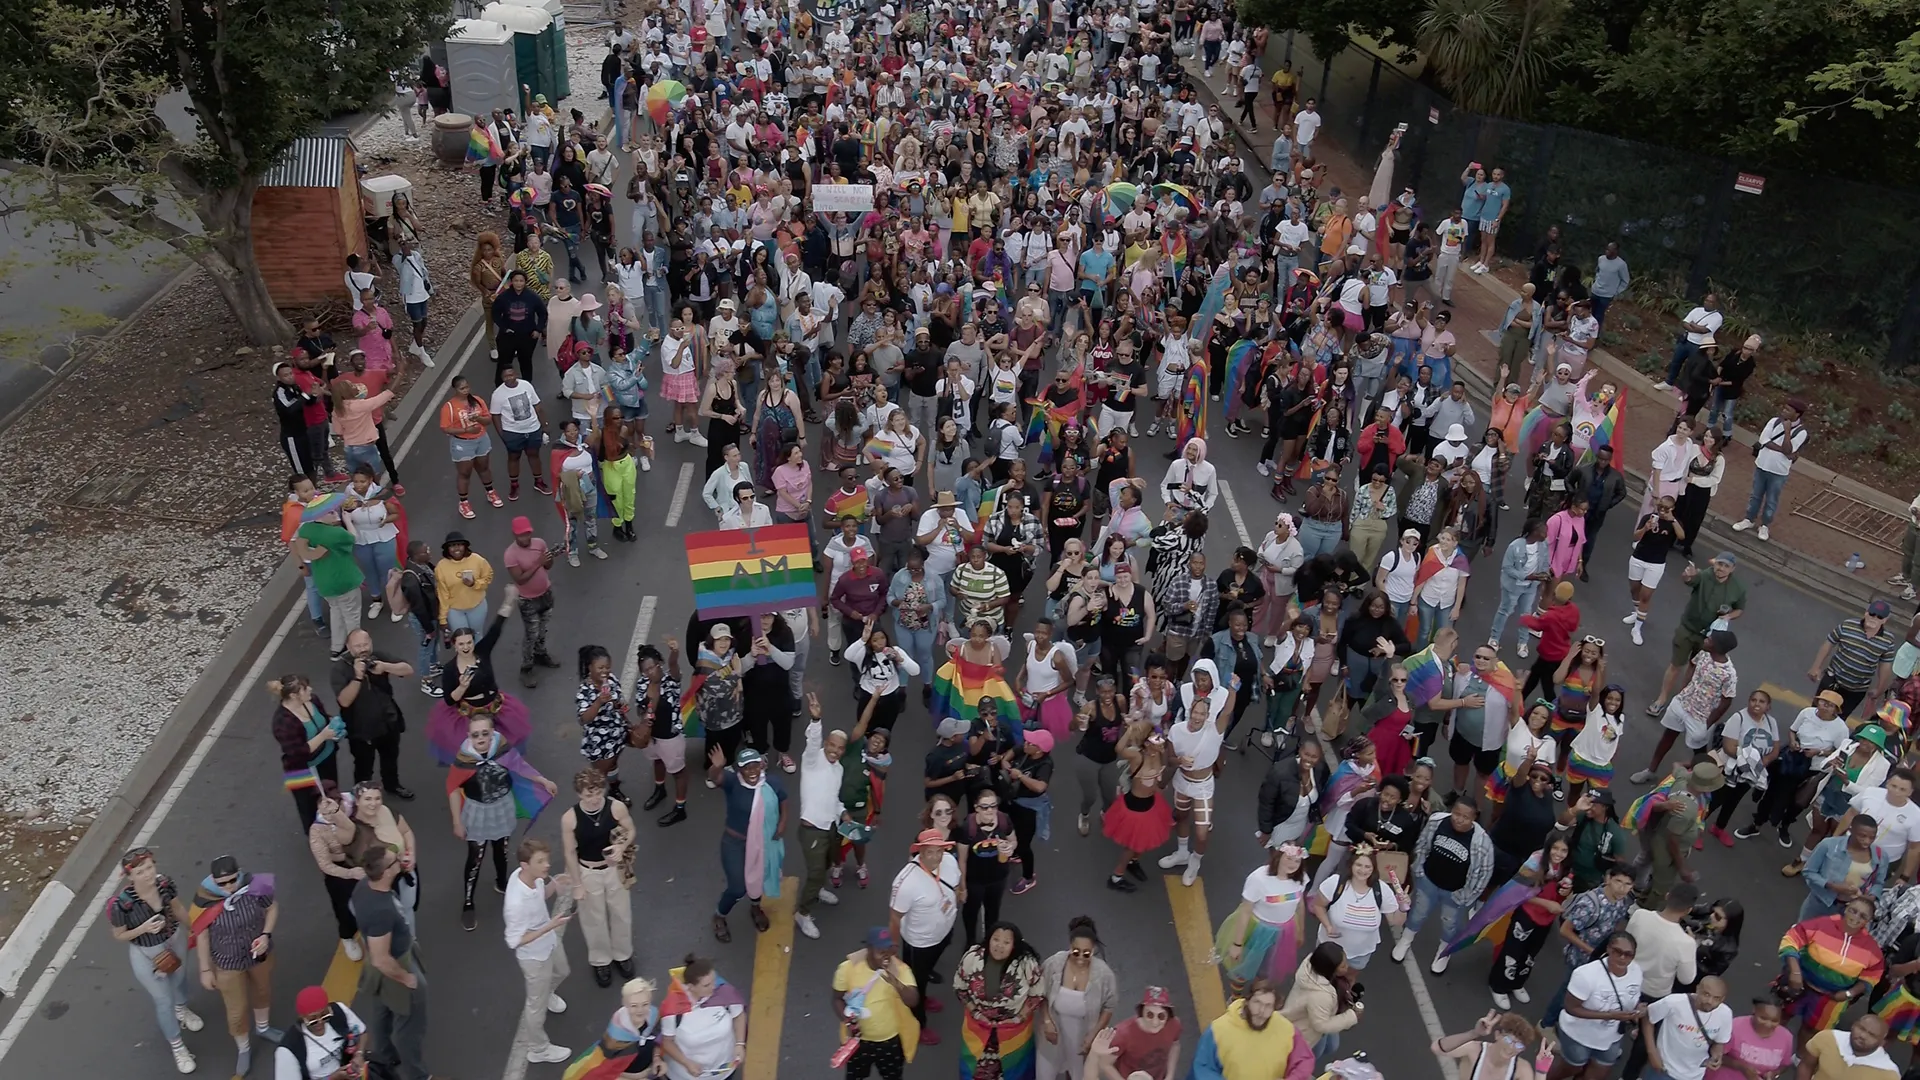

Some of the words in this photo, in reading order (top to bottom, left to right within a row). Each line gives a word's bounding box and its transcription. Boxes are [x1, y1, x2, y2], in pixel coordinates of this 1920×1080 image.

[826, 185, 846, 194] WILL
[852, 185, 870, 194] NOT
[1093, 350, 1113, 359] NASA
[741, 528, 765, 555] I
[730, 555, 790, 589] AM
